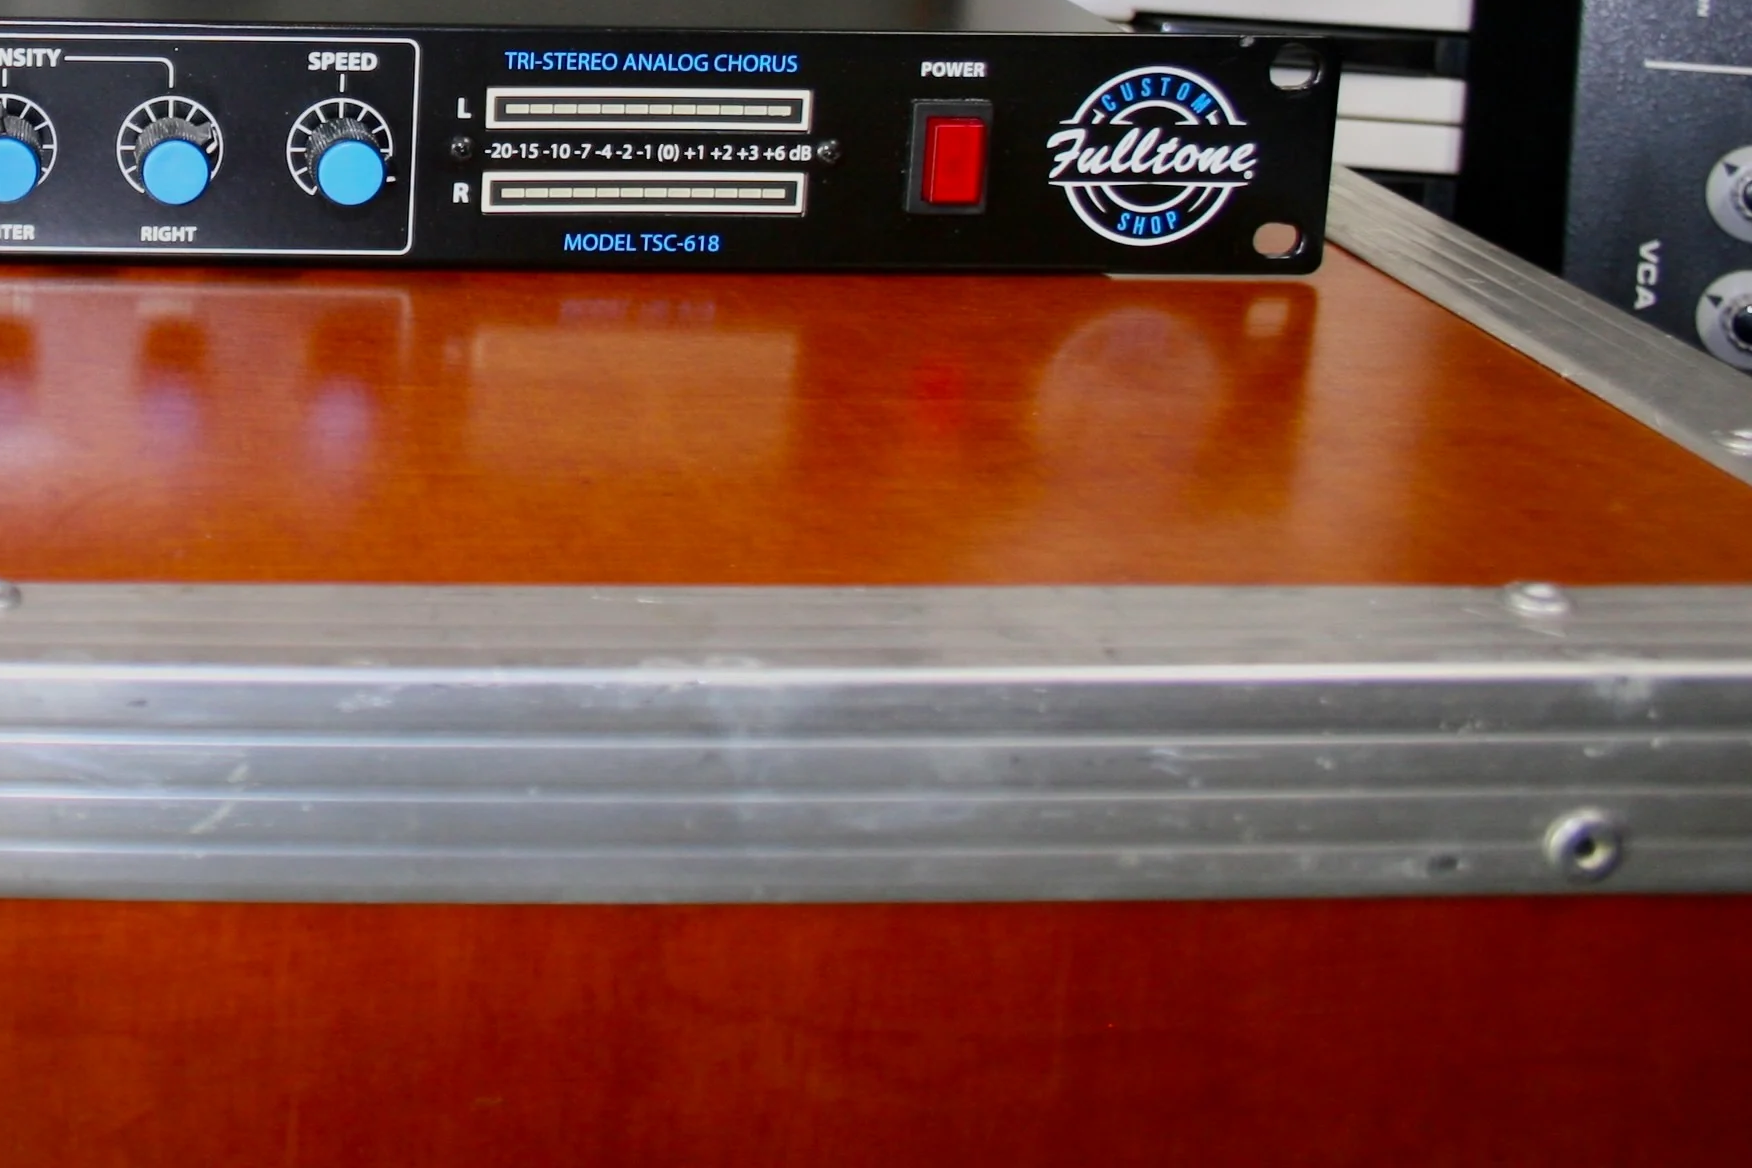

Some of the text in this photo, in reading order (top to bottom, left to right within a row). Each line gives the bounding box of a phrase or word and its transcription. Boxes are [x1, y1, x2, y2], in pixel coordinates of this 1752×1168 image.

[307, 51, 378, 72] SPEED
[504, 51, 799, 74] TRI-STEREO ANALOG CHORUS
[920, 61, 987, 79] POWER
[1100, 76, 1214, 115] CUSTOM
[456, 97, 473, 120] L
[542, 142, 571, 160] -10
[573, 142, 592, 160] -7
[594, 143, 613, 160] -4
[615, 143, 633, 160] -2
[636, 143, 653, 160] -1
[657, 142, 680, 163] (0)
[684, 143, 705, 160] +1
[710, 144, 733, 161] +2
[736, 144, 759, 161] +3
[762, 144, 786, 161] +6
[788, 143, 813, 162] dB
[1046, 125, 1257, 180] Fulltone
[452, 182, 470, 204] R
[140, 225, 198, 243] RIGHT
[1117, 210, 1181, 236] SHOP
[563, 233, 721, 253] MODEL TSC-618
[1633, 238, 1661, 311] VCA
